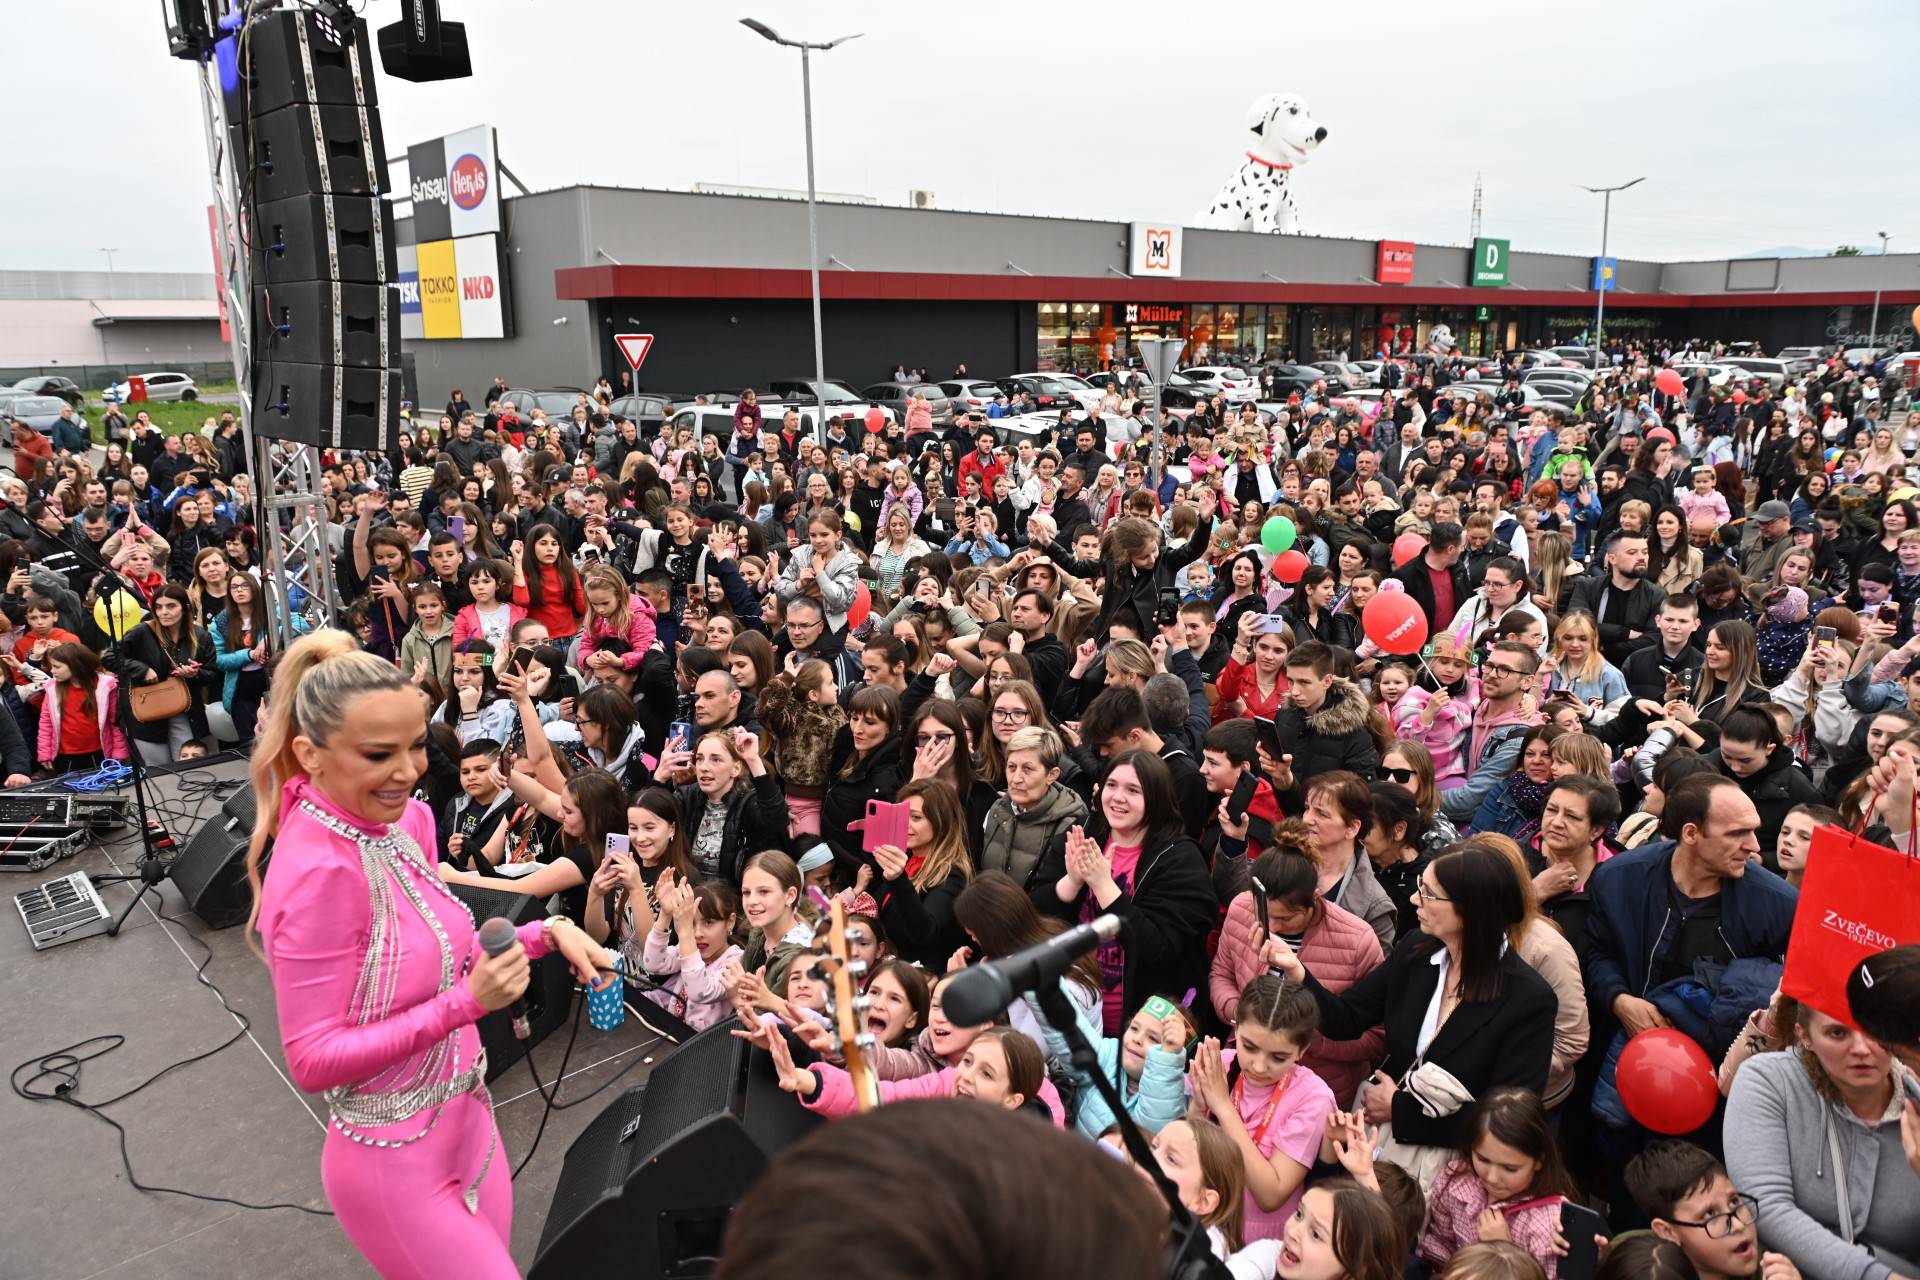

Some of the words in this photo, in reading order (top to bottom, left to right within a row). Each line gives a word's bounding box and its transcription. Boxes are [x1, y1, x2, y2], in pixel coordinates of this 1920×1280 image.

[411, 175, 448, 206] sinsay
[453, 168, 485, 198] Hervis
[1152, 241, 1165, 258] M
[1486, 244, 1499, 269] D
[462, 275, 494, 300] NKD
[1140, 305, 1183, 322] Müller
[1823, 909, 1896, 949] ZVEČEVO
[1151, 999, 1166, 1013] D
